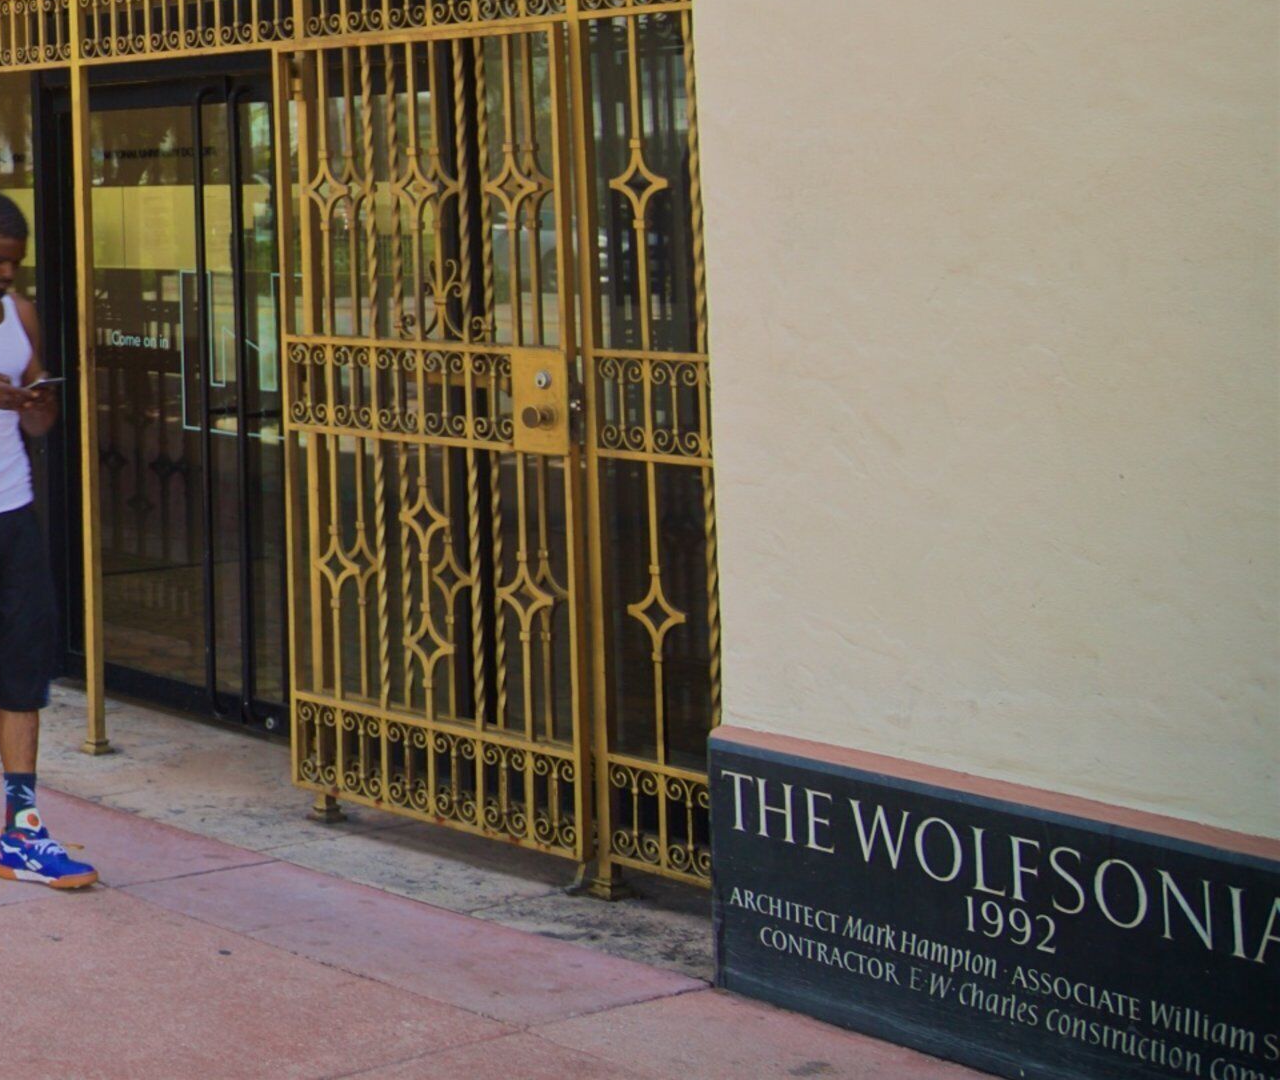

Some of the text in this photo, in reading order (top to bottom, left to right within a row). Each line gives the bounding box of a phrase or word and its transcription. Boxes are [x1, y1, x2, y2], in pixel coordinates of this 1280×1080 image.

[111, 330, 170, 350] Come on in
[721, 769, 835, 854] THE
[964, 895, 1057, 954] 1992
[729, 886, 840, 934] ARCHITECT
[842, 915, 897, 951] Mark
[899, 930, 997, 980] Hampton
[1011, 965, 1142, 1022] ASSOCIATE
[1150, 1000, 1255, 1055] William
[759, 926, 901, 986] CONTRACTOR
[958, 982, 1039, 1027] Charles
[1046, 1007, 1200, 1077] Construction
